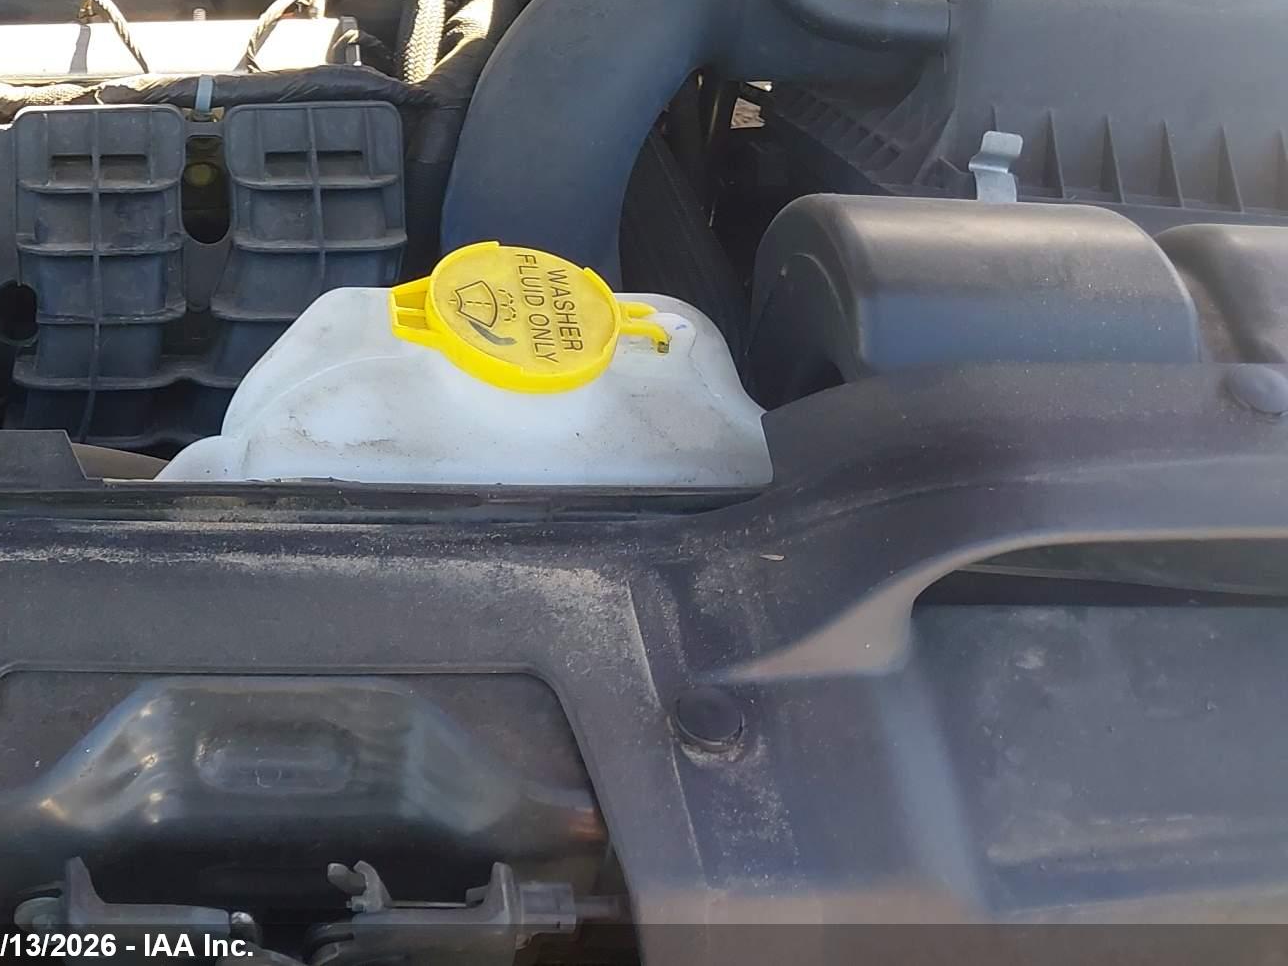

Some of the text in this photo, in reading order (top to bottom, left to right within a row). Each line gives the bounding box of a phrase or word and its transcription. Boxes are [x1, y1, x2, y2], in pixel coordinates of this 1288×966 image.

[515, 253, 560, 363] FLUID ONLY
[546, 269, 584, 352] WASHER
